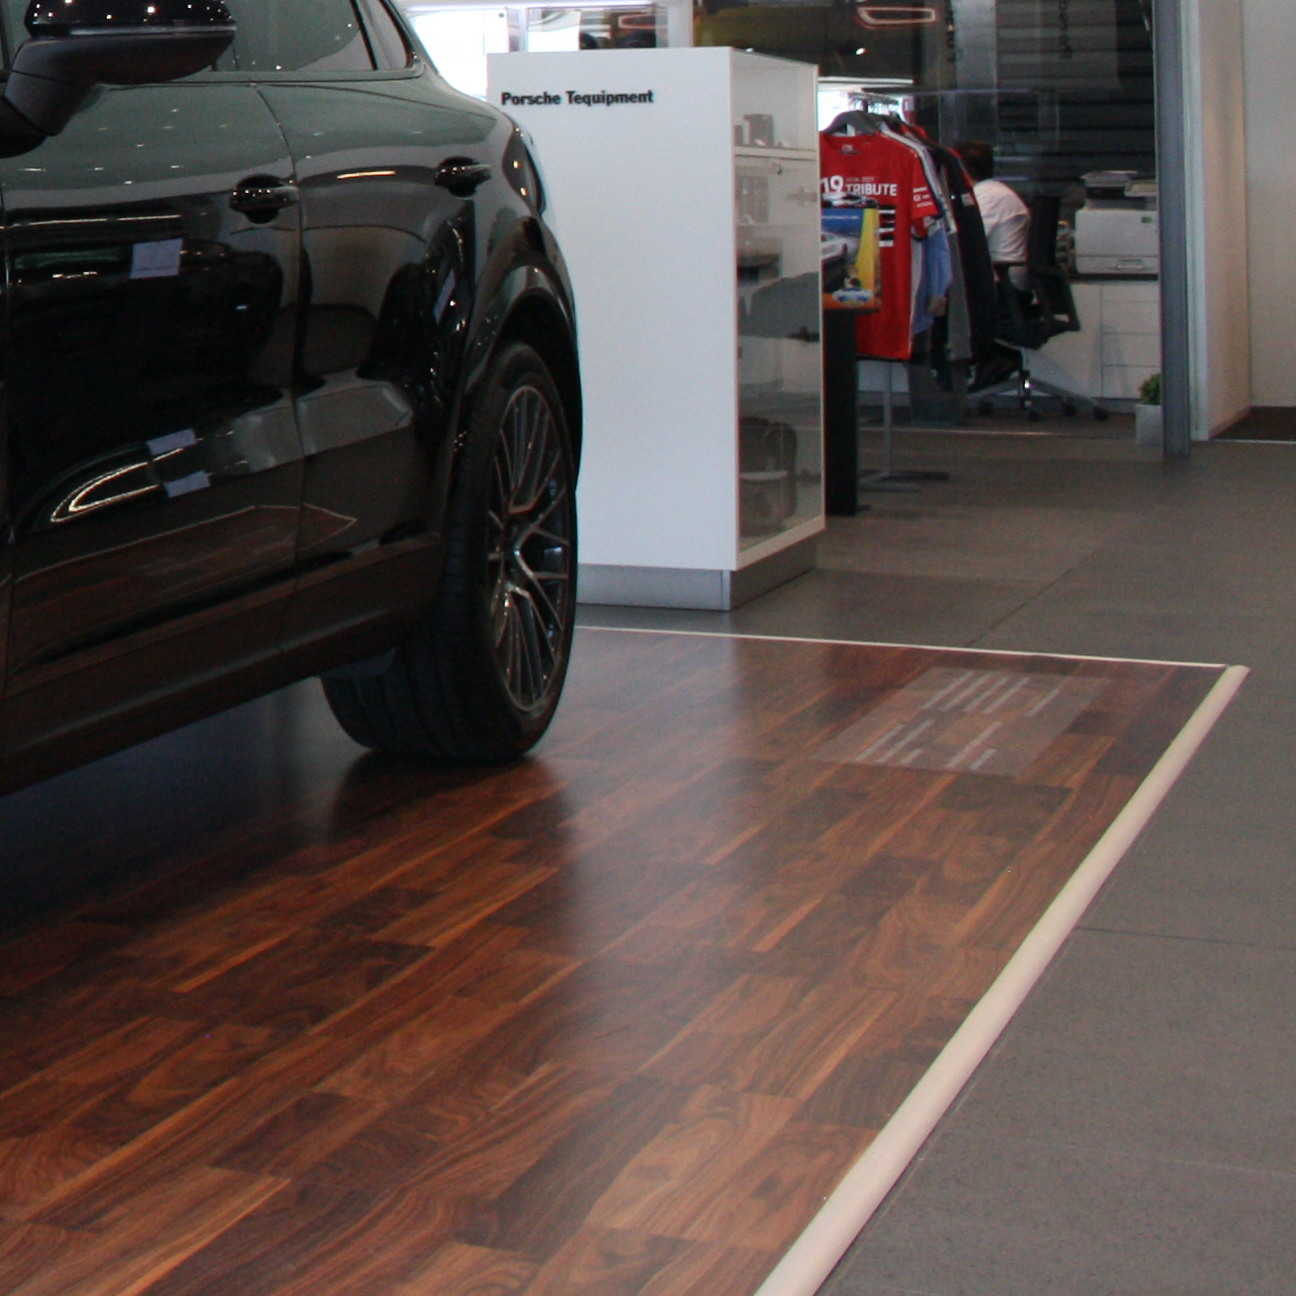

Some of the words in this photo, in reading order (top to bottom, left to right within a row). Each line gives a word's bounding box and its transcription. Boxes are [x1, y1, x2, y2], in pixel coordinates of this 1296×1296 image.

[501, 91, 561, 106] Porsche
[566, 89, 654, 107] Tequipment
[819, 175, 844, 193] 19
[846, 183, 897, 197] TRIBUTE
